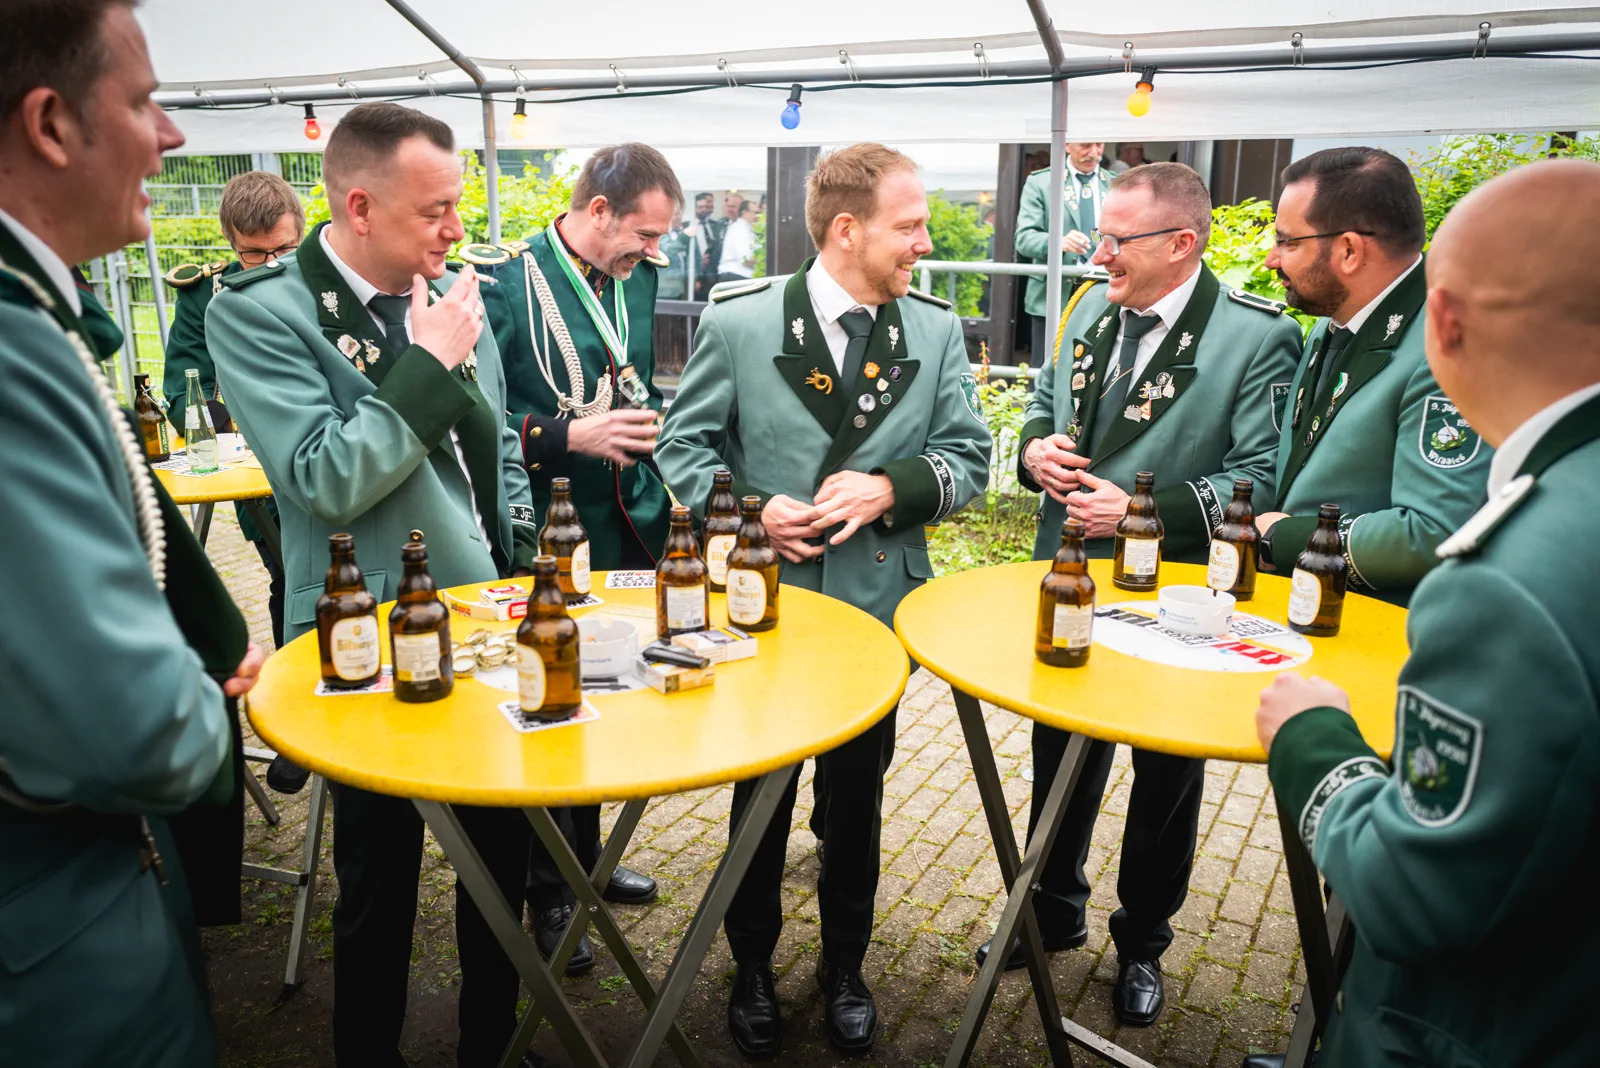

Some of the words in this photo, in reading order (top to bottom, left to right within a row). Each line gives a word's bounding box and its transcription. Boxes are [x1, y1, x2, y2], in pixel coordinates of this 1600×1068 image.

[1431, 402, 1440, 411] 9.
[1200, 486, 1210, 504] Jgz.
[509, 507, 518, 517] 9.
